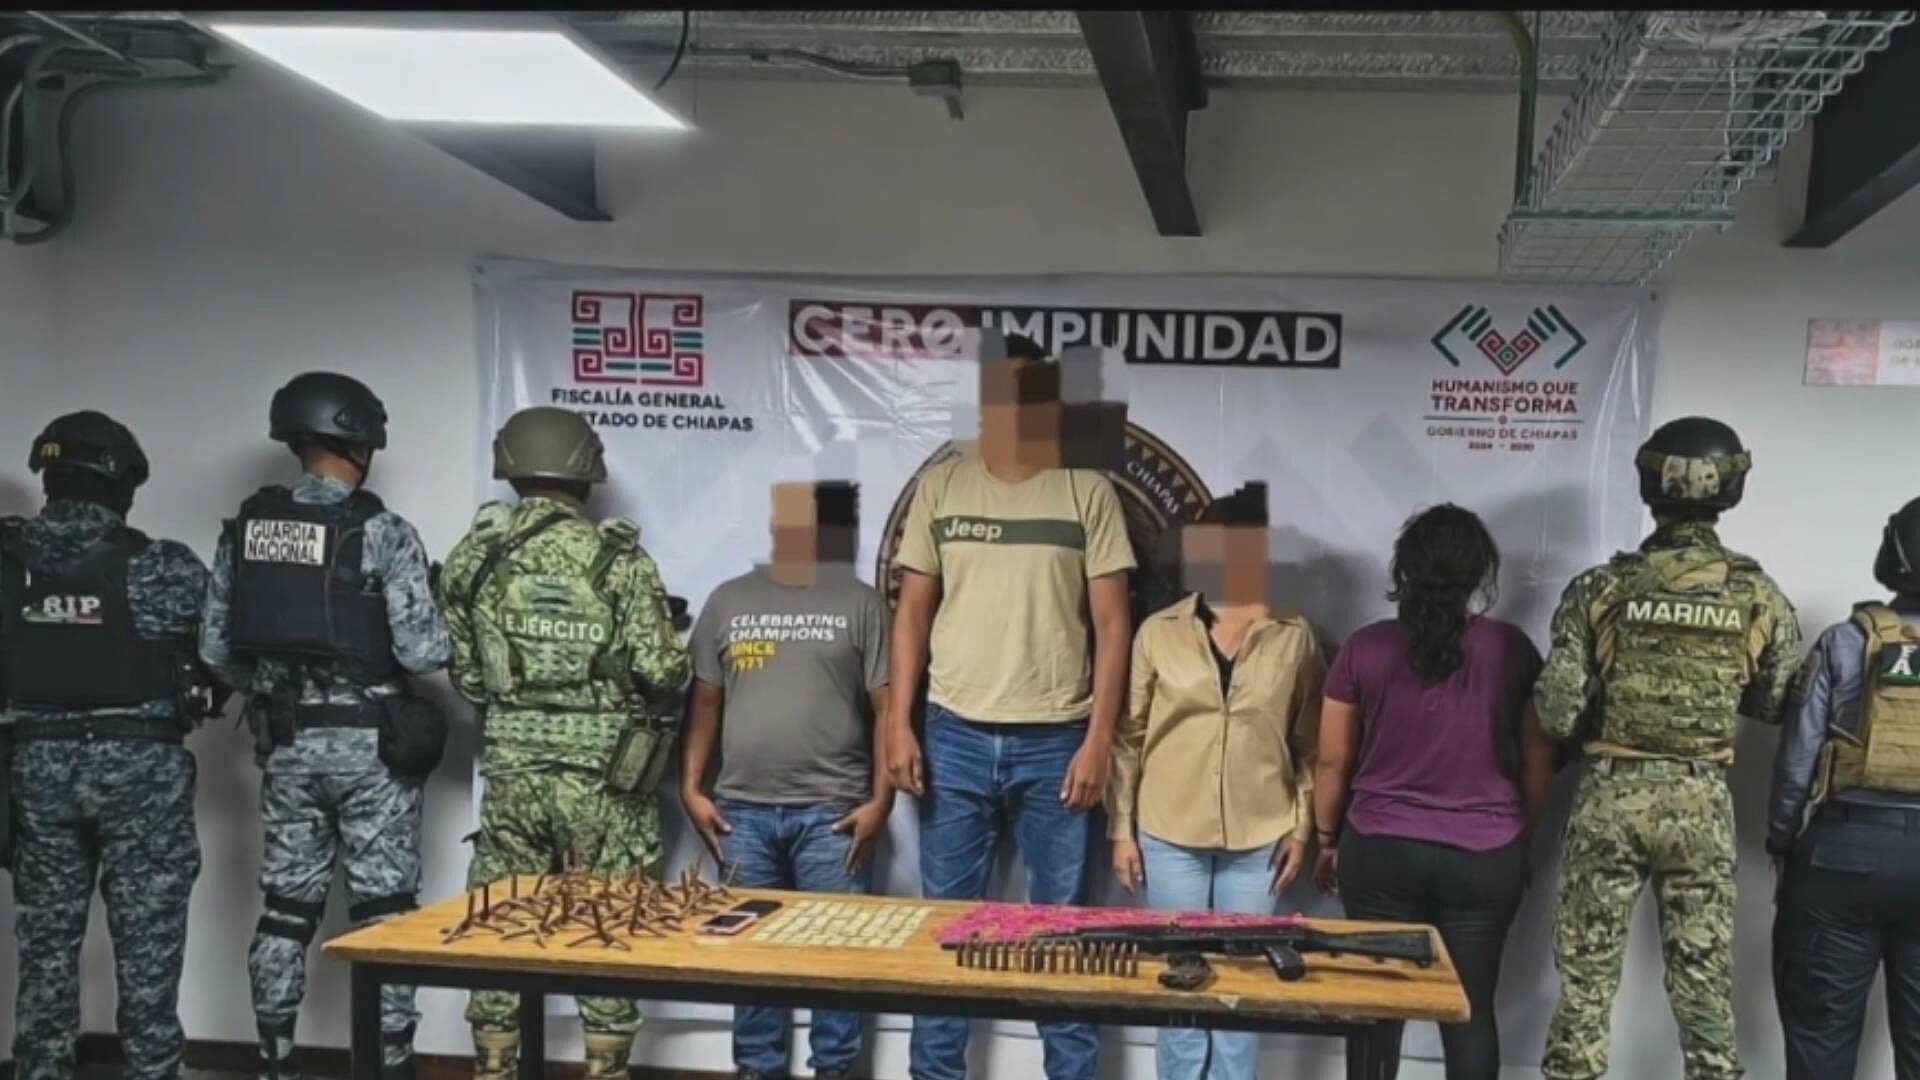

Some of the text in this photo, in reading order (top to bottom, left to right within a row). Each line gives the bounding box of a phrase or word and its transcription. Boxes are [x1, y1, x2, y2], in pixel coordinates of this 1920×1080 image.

[1431, 379, 1579, 395] HUMANISMO QUE
[551, 387, 726, 410] FISCALÍA GENERAL
[1431, 395, 1578, 414] TRANSFORMA
[643, 412, 669, 428] DE
[672, 414, 754, 432] CHIAPAS
[1426, 426, 1578, 440] GOBIERNO DE CHIAPAS
[252, 520, 318, 541] GUARDIA
[944, 518, 1003, 543] Jeep
[247, 539, 316, 562] NACIONAL
[730, 613, 848, 629] CELEBRATING
[1626, 600, 1741, 630] MARINA
[729, 627, 836, 642] CHAMPIONS
